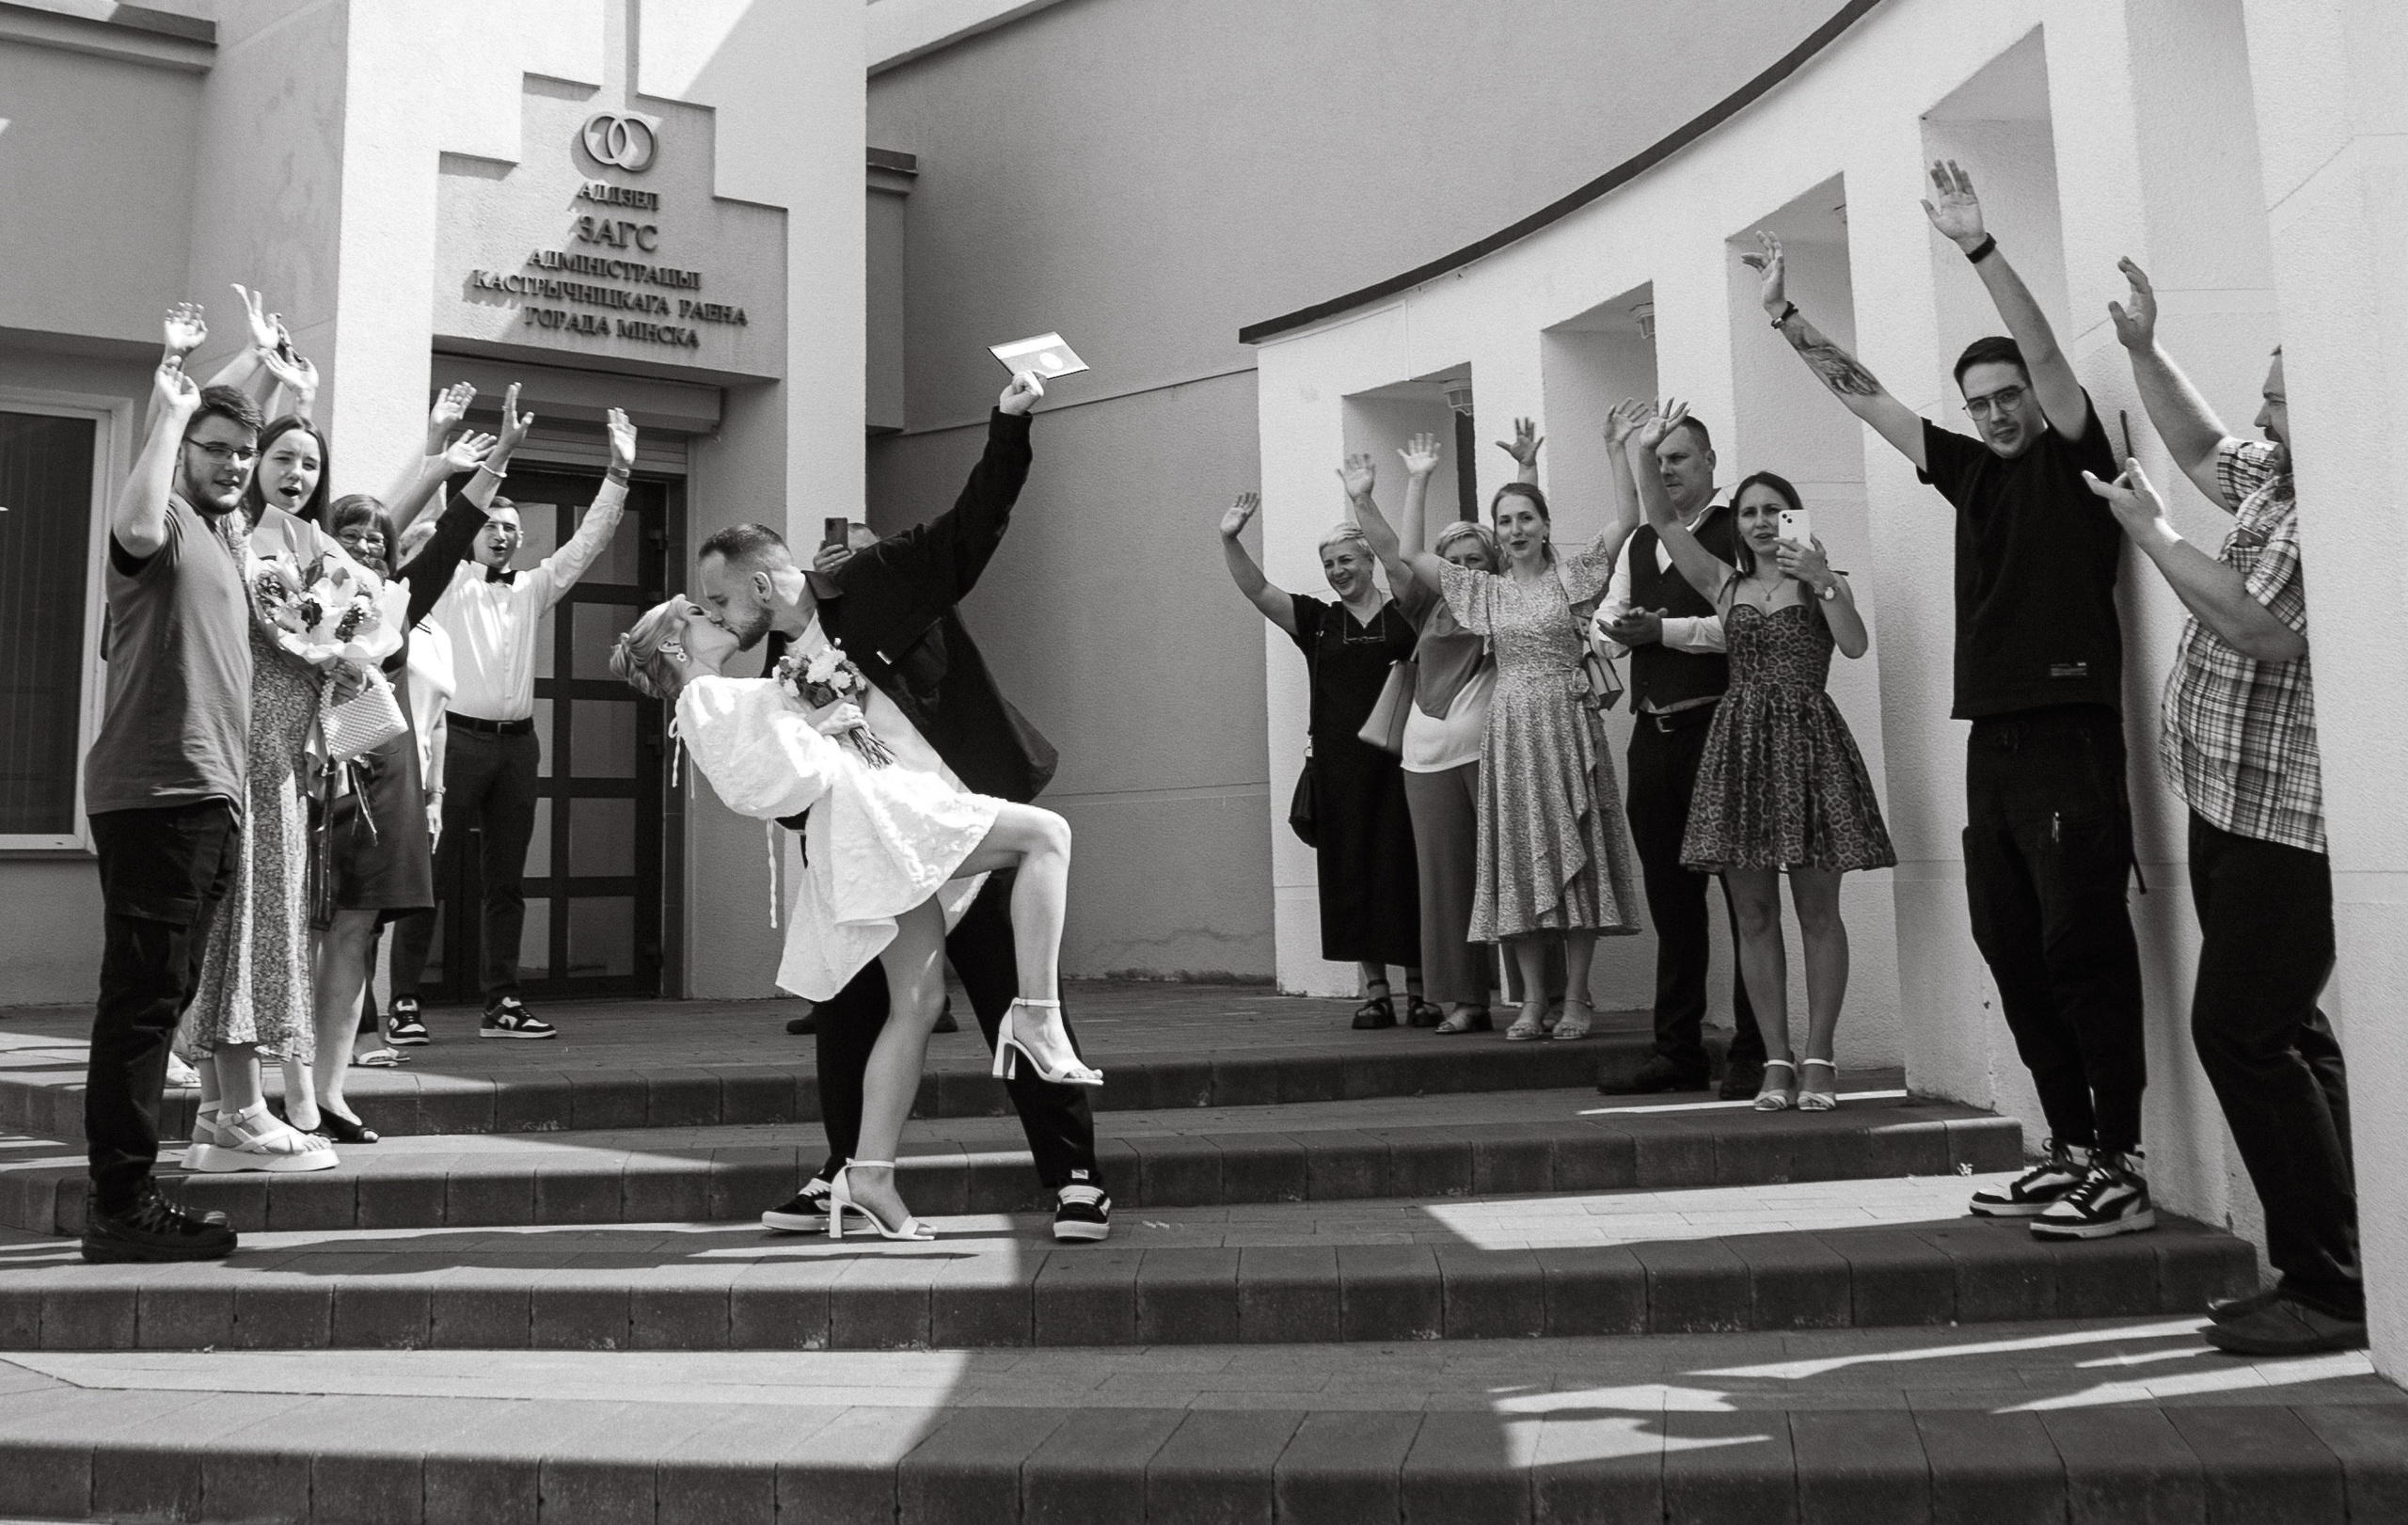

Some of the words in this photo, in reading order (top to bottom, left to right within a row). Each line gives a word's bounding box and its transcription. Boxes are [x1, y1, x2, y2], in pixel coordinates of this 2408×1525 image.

[577, 183, 660, 212] АДДЗЕЛ
[577, 215, 658, 252] ЗАГС
[524, 306, 611, 336] ГОРАДА
[616, 318, 701, 349] МІНСКА
